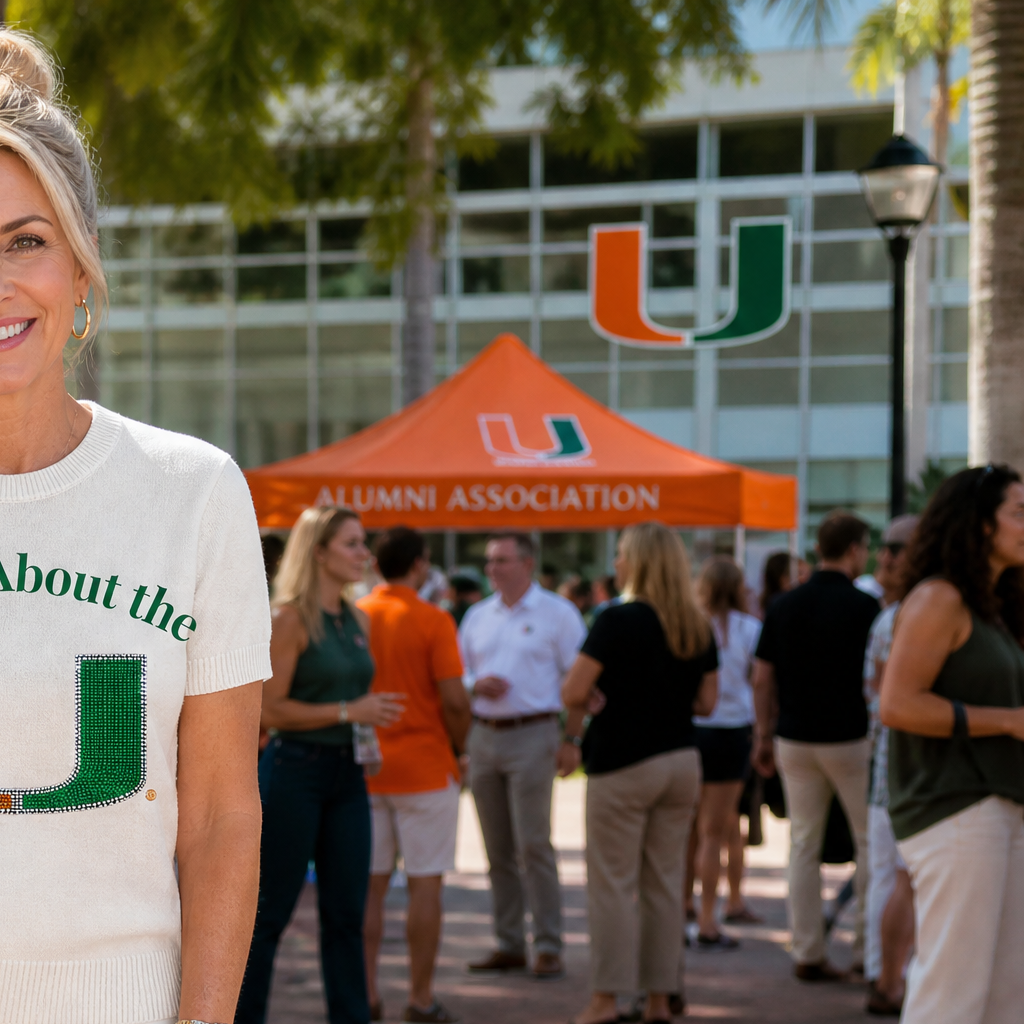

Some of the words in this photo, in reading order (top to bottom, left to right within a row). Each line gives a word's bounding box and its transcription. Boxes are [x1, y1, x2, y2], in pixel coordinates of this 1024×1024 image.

[589, 215, 793, 350] U
[477, 413, 592, 461] U
[314, 485, 437, 512] ALUMNI
[446, 484, 661, 513] ASSOCIATION
[128, 584, 198, 642] the
